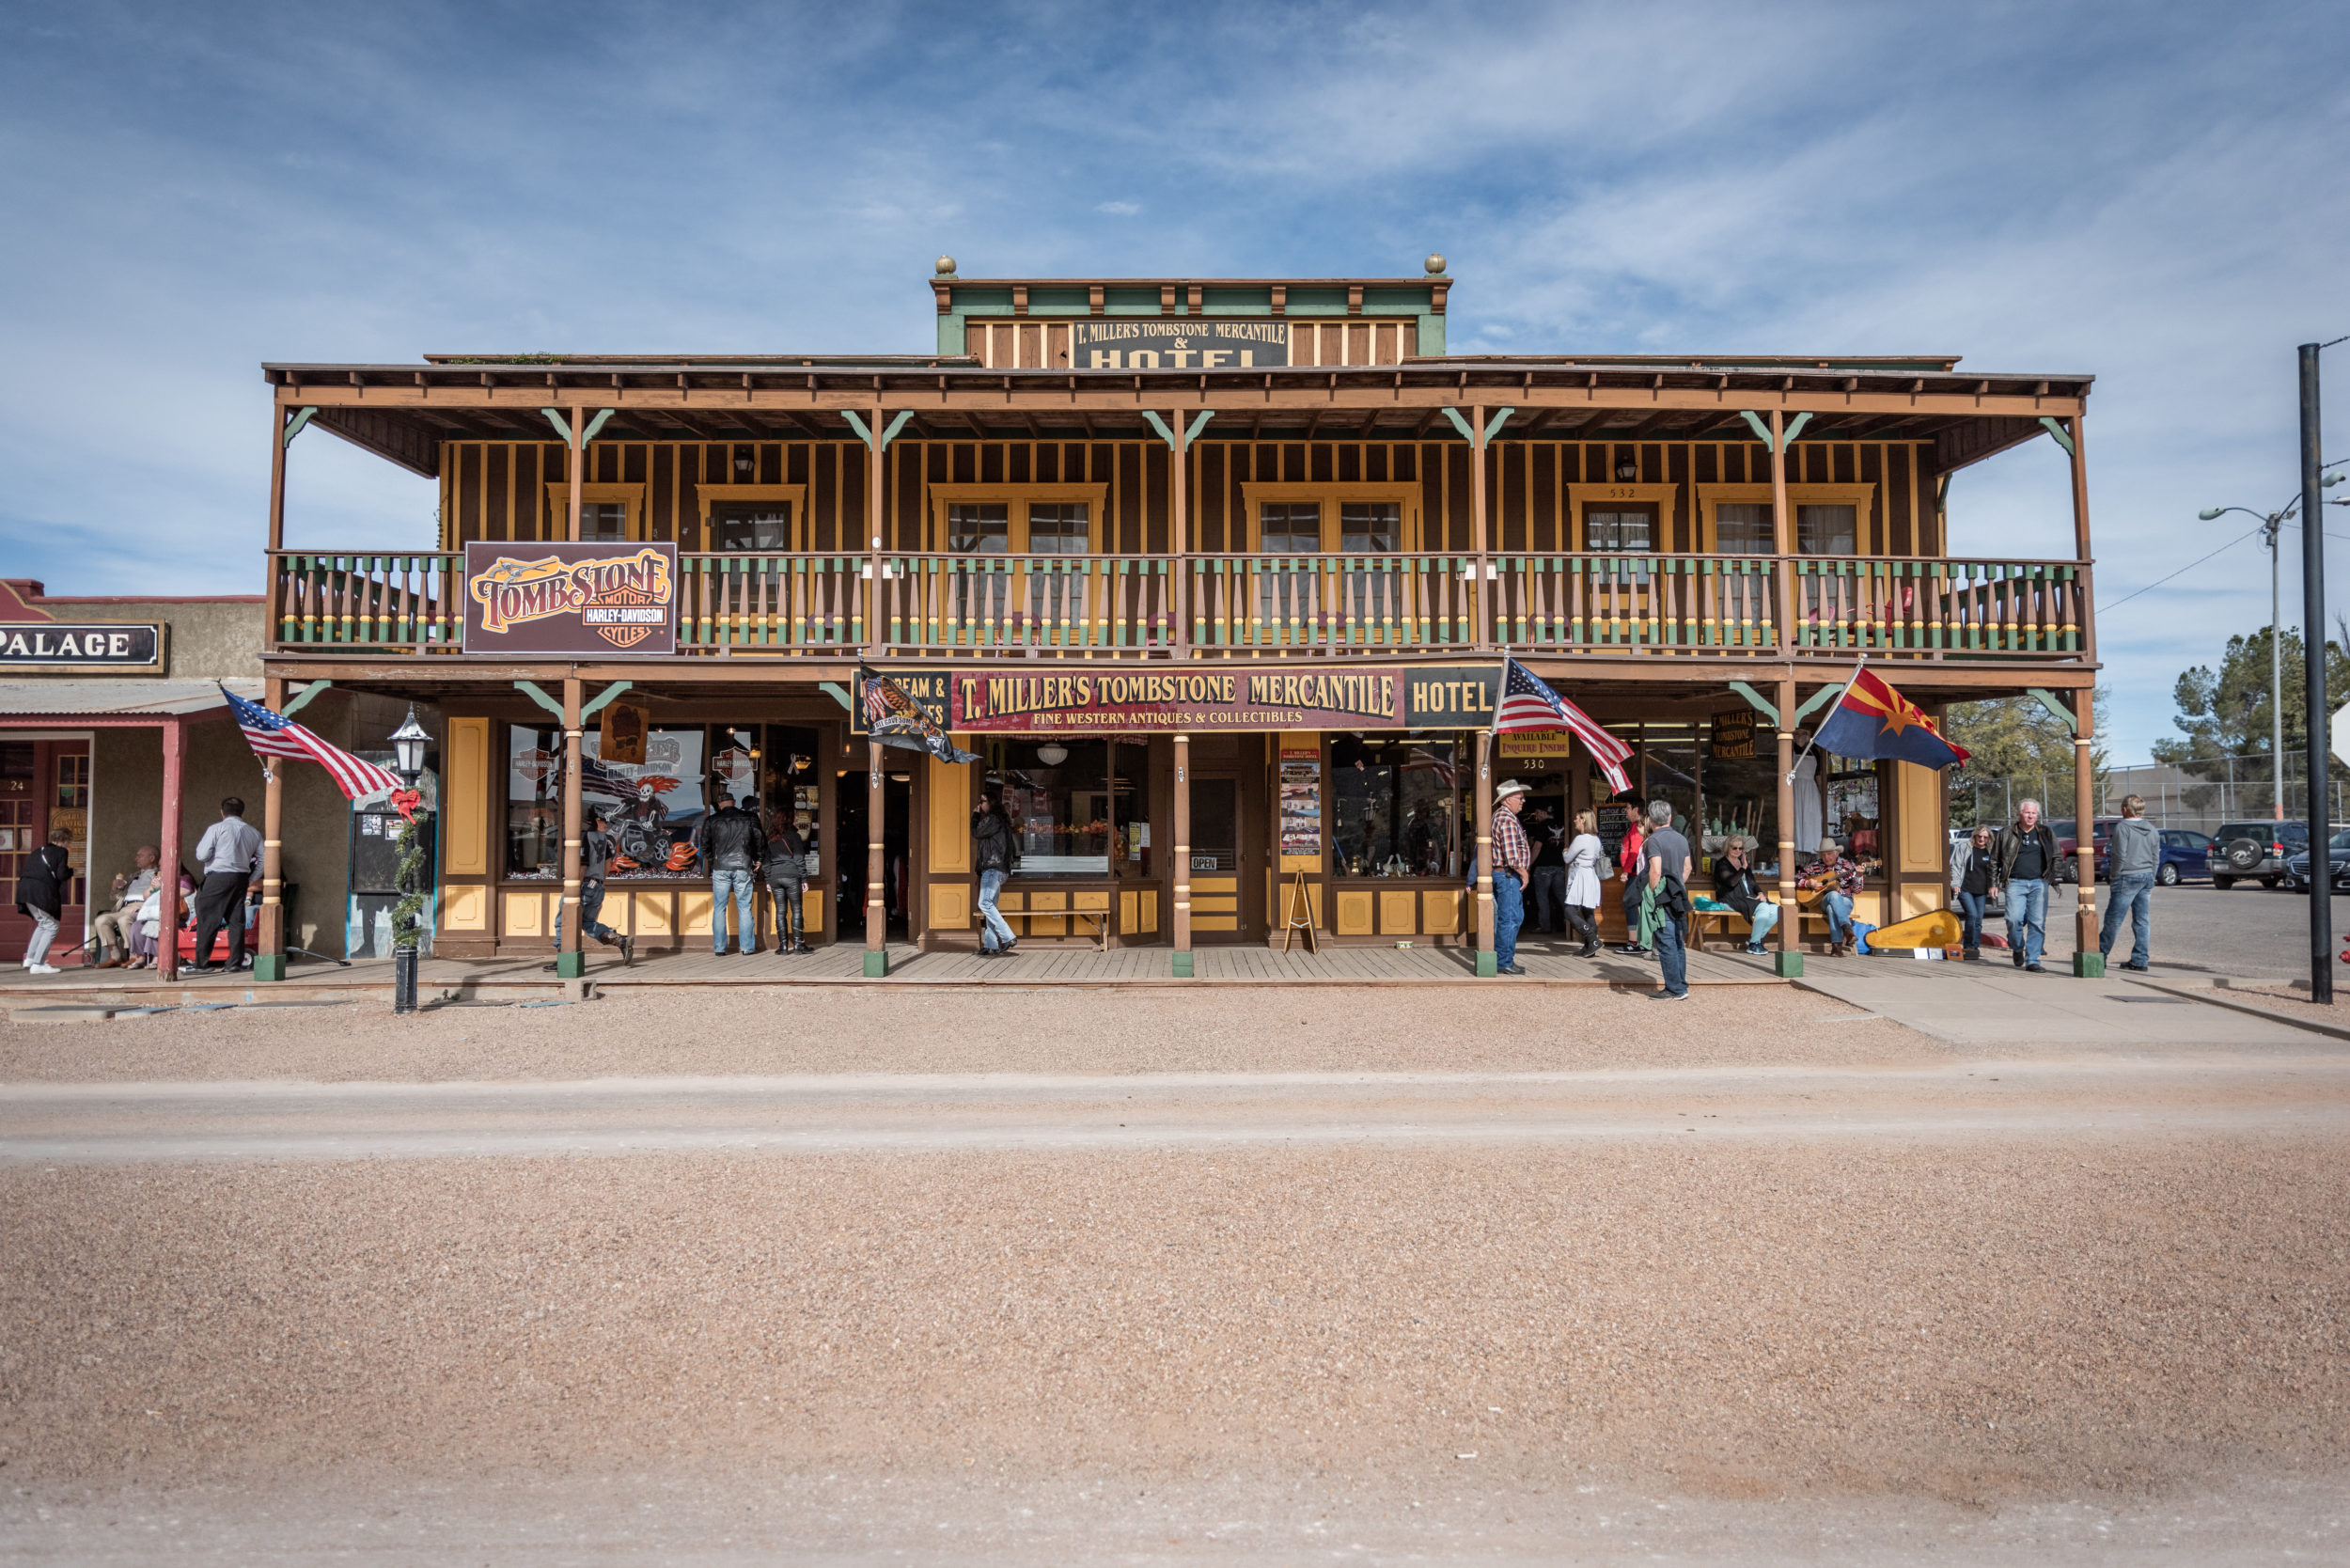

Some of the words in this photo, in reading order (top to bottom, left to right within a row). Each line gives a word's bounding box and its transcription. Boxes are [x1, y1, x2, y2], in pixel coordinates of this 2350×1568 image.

[1076, 323, 1087, 345] T.
[1089, 323, 1139, 343] MILLER'S
[1142, 322, 1210, 337] TOMBSTONE
[1215, 323, 1286, 345] MERCANTILE
[1174, 337, 1188, 349] &
[1610, 488, 1635, 498] 532
[477, 555, 666, 628] TOMBSTONE
[604, 591, 647, 605] MOTOR
[586, 607, 664, 624] HARLEY-DAVIDSON
[603, 626, 645, 645] CYCLES
[935, 677, 945, 698] &
[961, 678, 981, 720] T.
[988, 675, 1091, 716] MILLER'S
[1098, 675, 1236, 704] TOMBSTONE
[1250, 674, 1395, 718] MERCANTILE
[1413, 682, 1494, 713] HOTEL
[1034, 713, 1062, 725] FINE
[1066, 713, 1125, 725] WESTERN
[1129, 713, 1190, 726] ANTIQUES
[1195, 713, 1205, 724] &
[1209, 711, 1303, 724] COLLECTIBLES
[1512, 733, 1557, 742] AVAILABLE
[1502, 743, 1538, 754] INQUIRE
[1539, 743, 1567, 754] INSIDE
[1713, 739, 1754, 759] MERCANTILE
[608, 762, 673, 779] HARLEY-DAVIDSON
[1524, 760, 1544, 769] 530
[1193, 857, 1215, 869] OPEN
